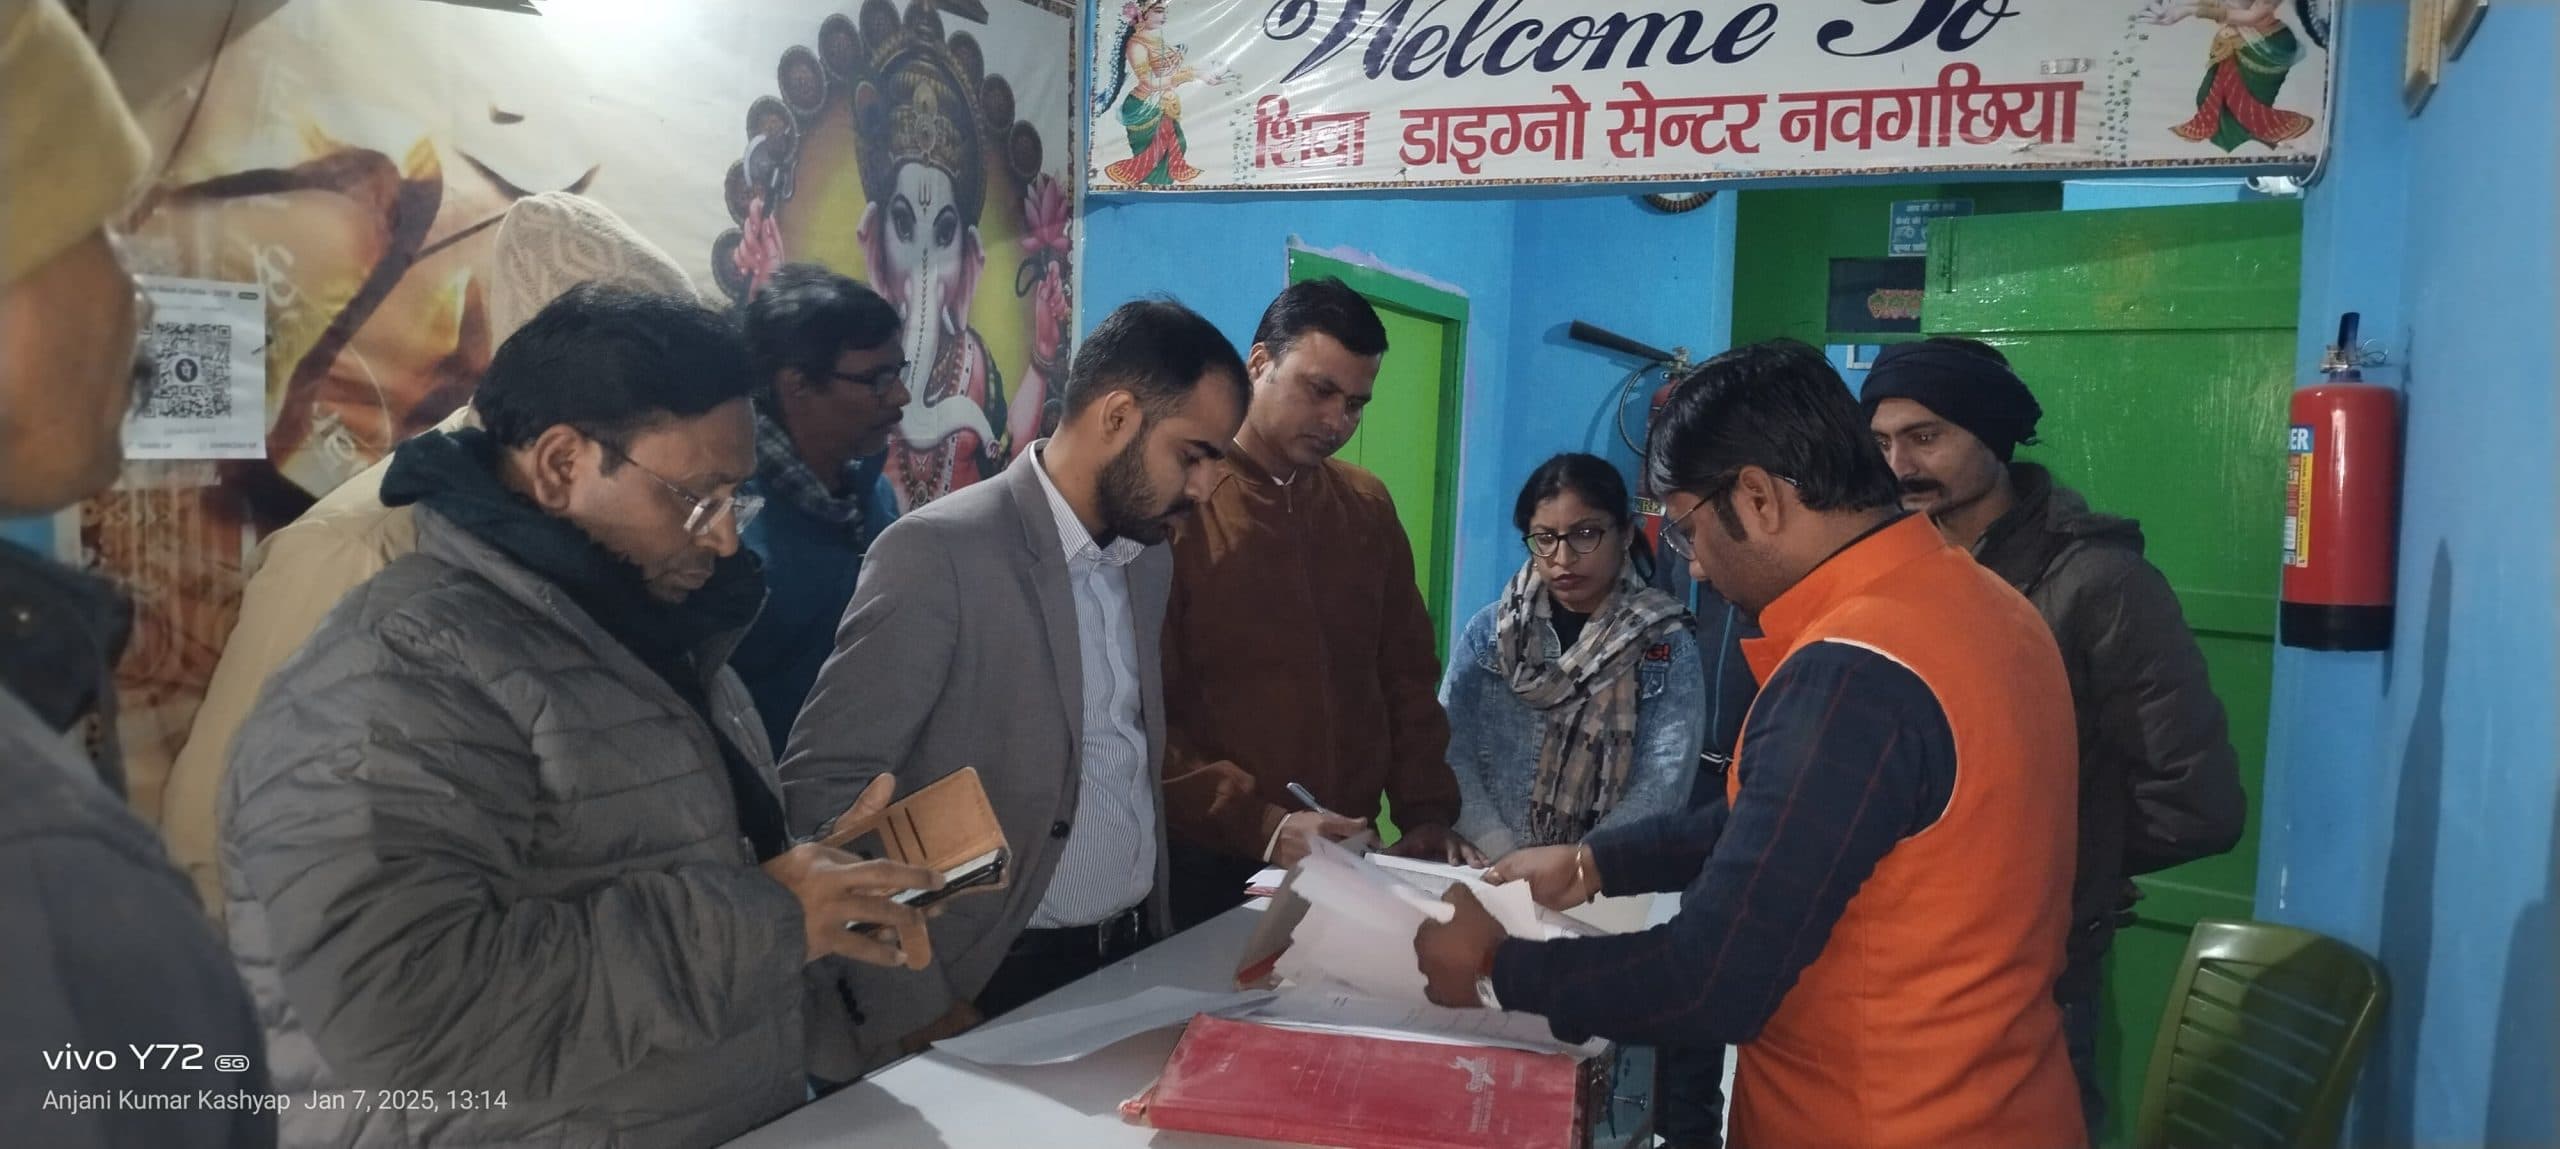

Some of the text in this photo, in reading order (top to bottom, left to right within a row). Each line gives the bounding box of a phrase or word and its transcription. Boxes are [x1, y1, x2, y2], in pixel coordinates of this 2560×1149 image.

[1263, 0, 1778, 84] Welcome
[1399, 85, 1591, 175] डाइग्नो
[1606, 81, 1767, 159] सेन्टर
[1779, 62, 2084, 152] नवगछिया
